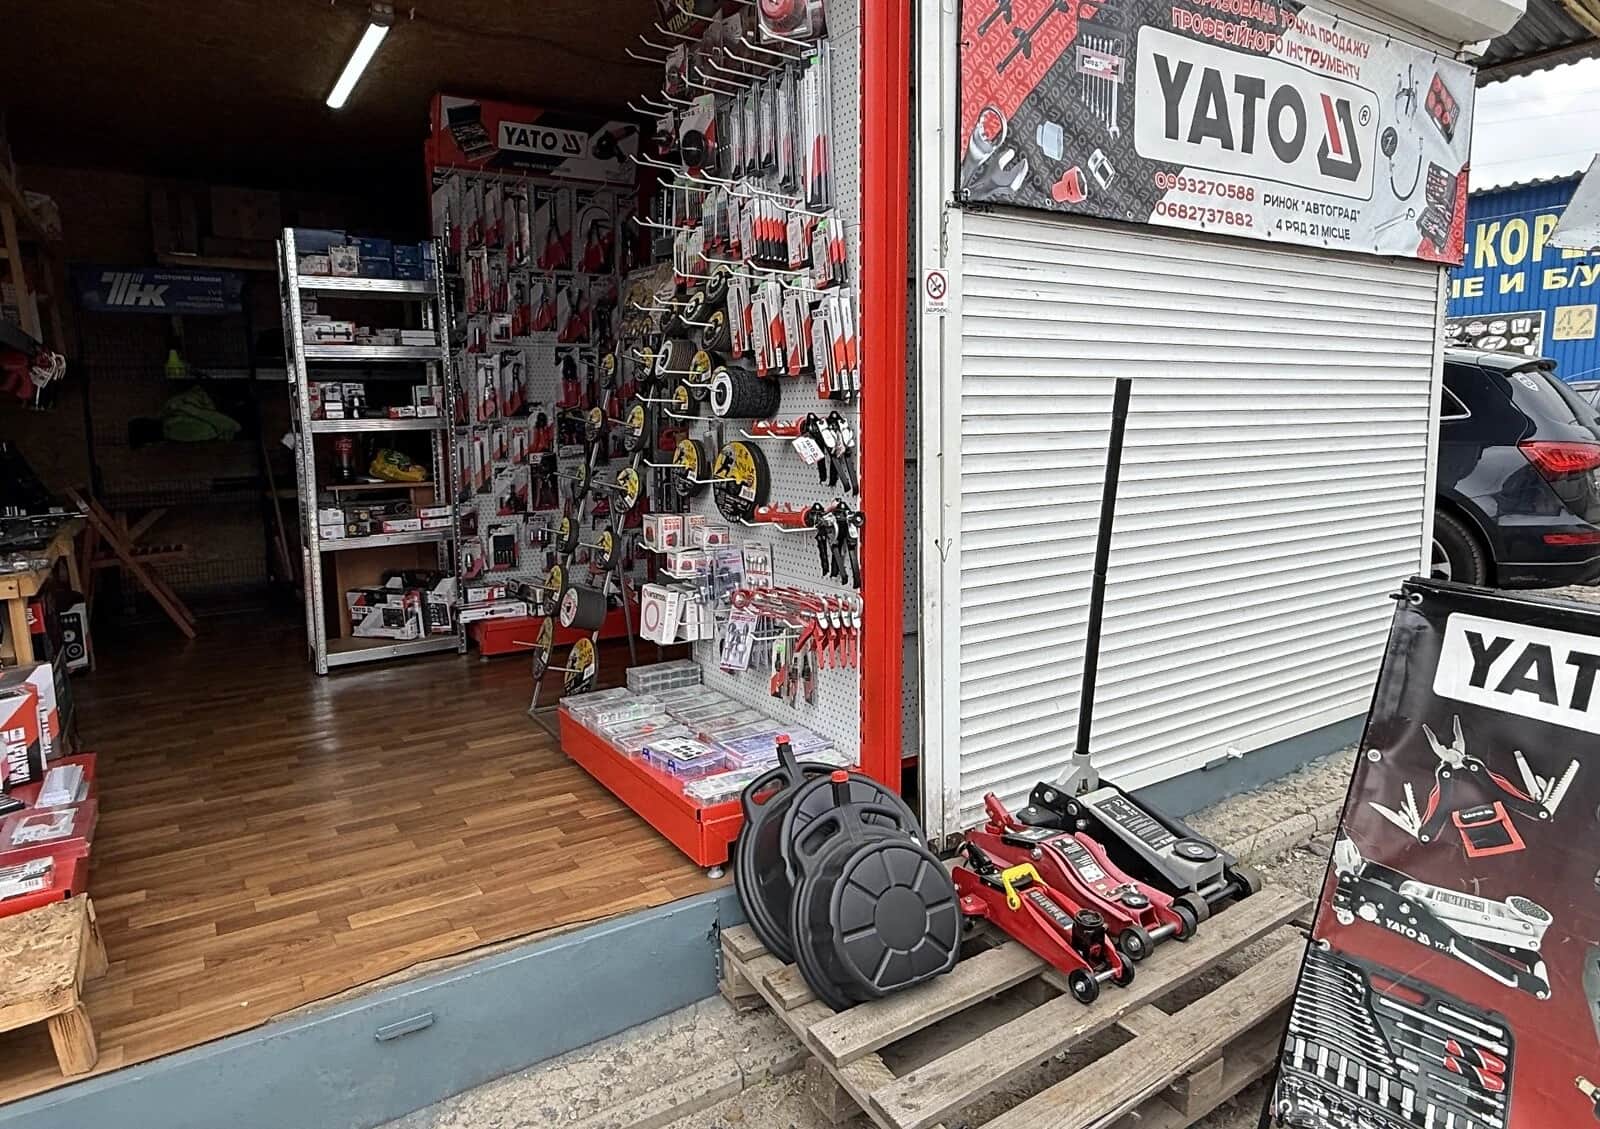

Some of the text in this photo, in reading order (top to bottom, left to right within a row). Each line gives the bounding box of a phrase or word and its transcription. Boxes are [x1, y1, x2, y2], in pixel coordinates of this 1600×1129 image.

[1172, 7, 1361, 80] ПРОФЕСІЙНОГО ІНСТРУМЕНТУ
[1279, 9, 1318, 39] ТОЧКА
[1319, 27, 1371, 59] ПРОДАЖУ
[1153, 53, 1307, 164] YATO
[504, 126, 558, 151] YATO
[1155, 172, 1255, 201] 0993270588
[1156, 202, 1254, 228] 0682737882
[1264, 194, 1300, 212] РИНОК
[1276, 219, 1351, 241] 4 РЯД 21 МІСЦЕ
[1499, 271, 1525, 295] И
[1542, 263, 1600, 291] Б/У
[1464, 629, 1600, 713] YAT
[1385, 917, 1417, 938] YATO
